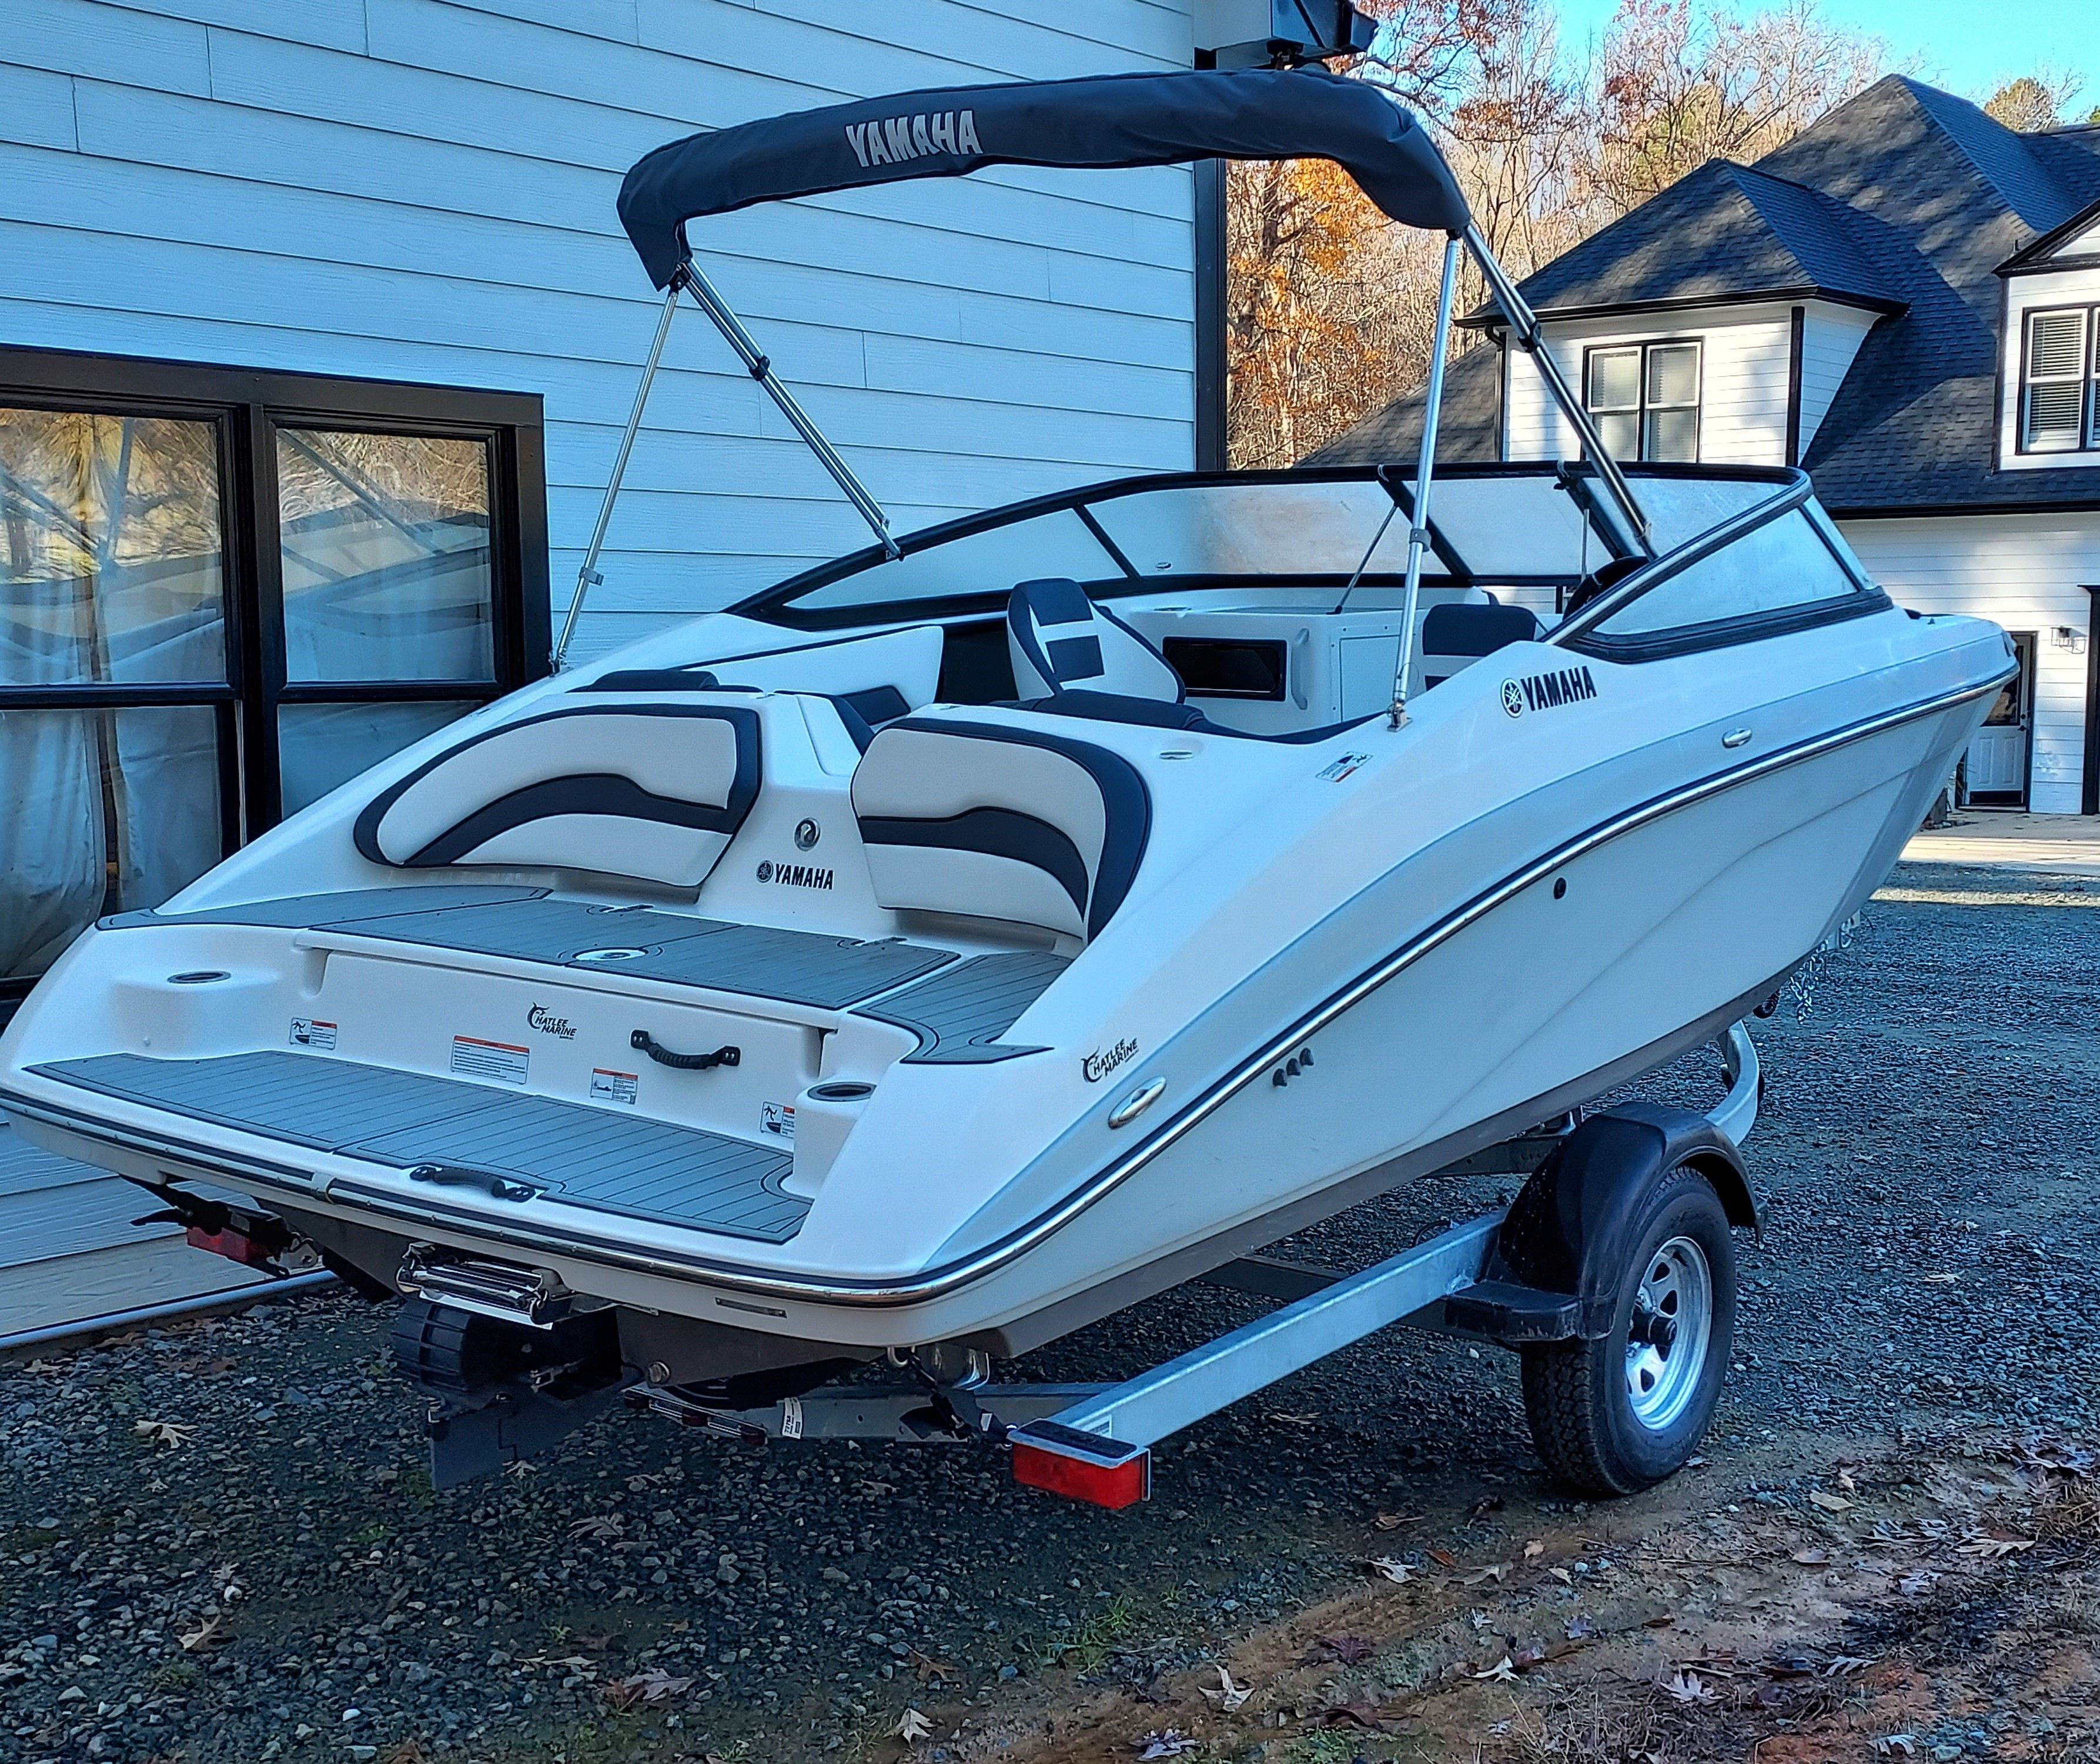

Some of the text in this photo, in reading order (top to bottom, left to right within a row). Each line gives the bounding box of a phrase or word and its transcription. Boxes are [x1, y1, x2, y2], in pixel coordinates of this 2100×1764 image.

[845, 110, 984, 167] YAMAHA
[1520, 666, 1597, 711] YAMAHA
[775, 863, 834, 890] YAMAHA
[527, 1002, 569, 1029] CHATLEE
[541, 1025, 577, 1036] MARINE
[1081, 1038, 1125, 1083] CHATLEE
[1105, 1038, 1138, 1077] MARINE
